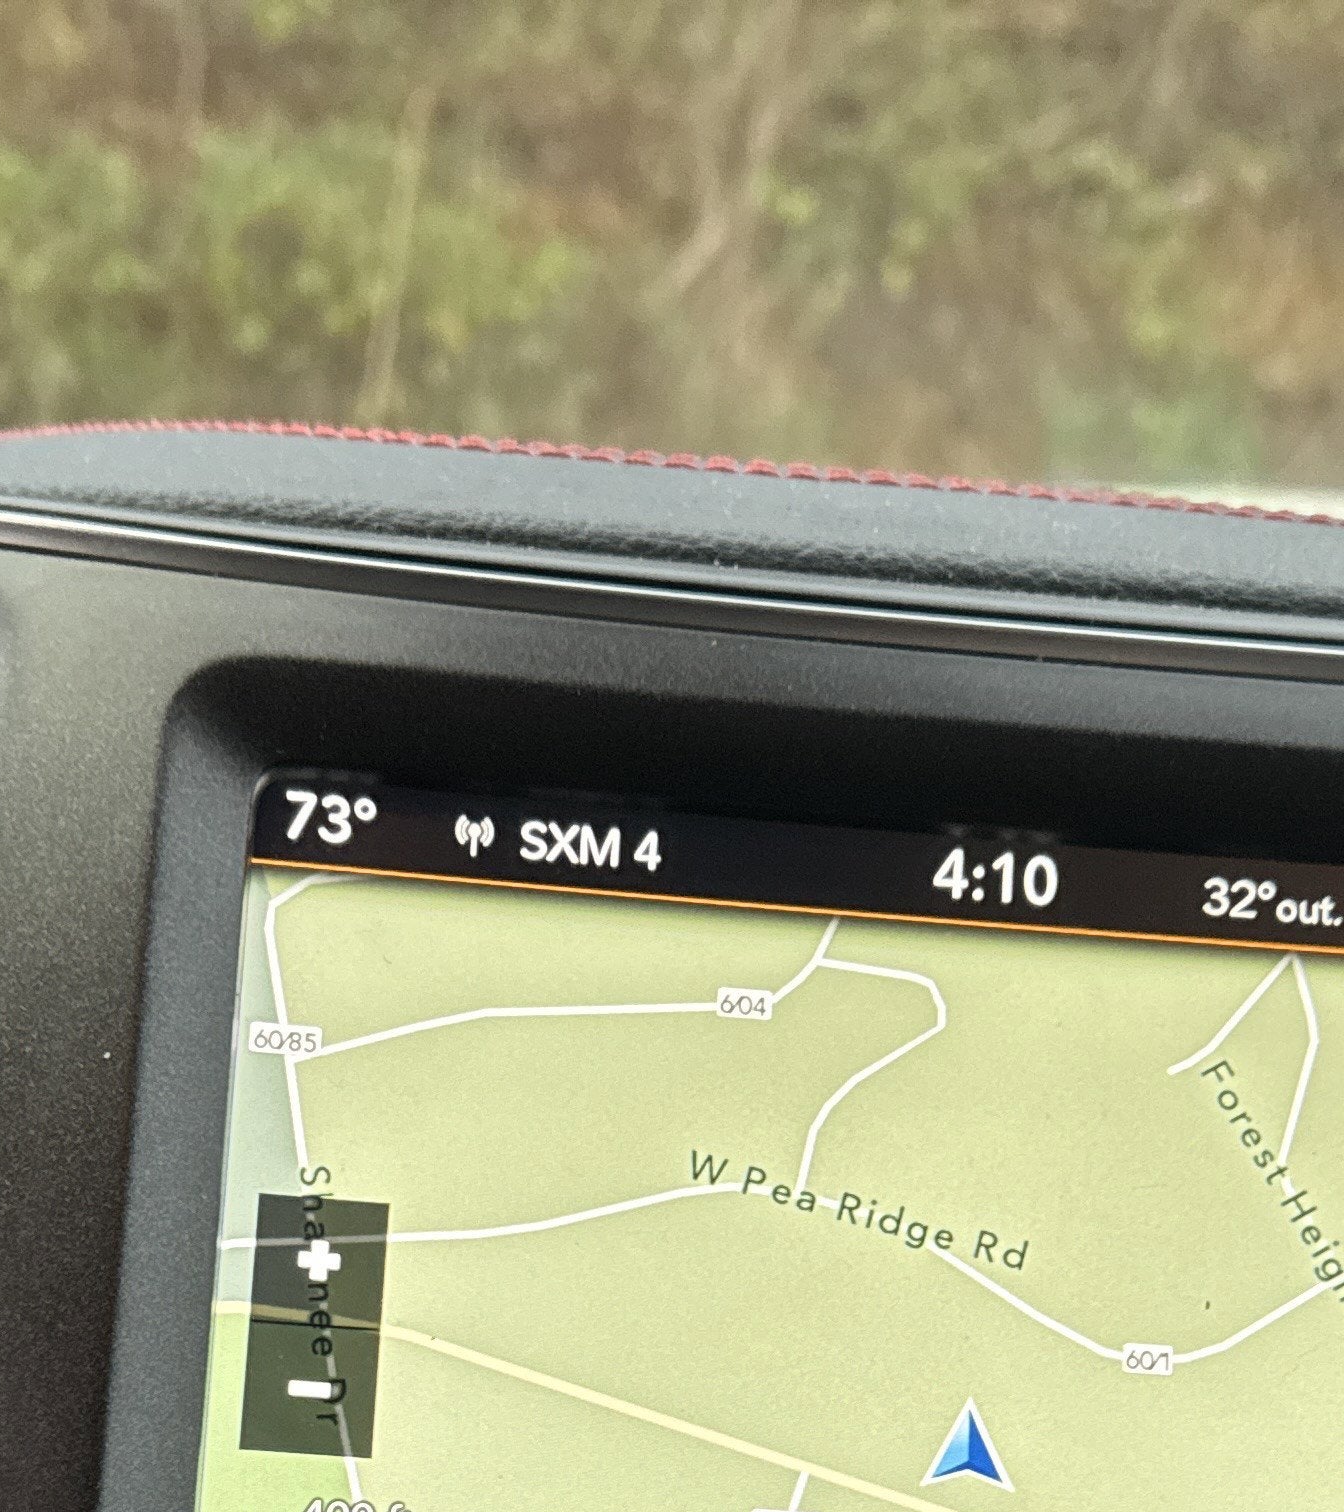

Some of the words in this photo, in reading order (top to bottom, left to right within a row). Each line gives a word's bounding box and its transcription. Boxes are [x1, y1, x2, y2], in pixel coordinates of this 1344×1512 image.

[284, 788, 379, 845] 73°
[518, 819, 622, 869] SXM
[632, 829, 663, 873] 4
[931, 846, 1059, 908] 4:10
[1200, 1059, 1288, 1186] Forest
[691, 1149, 729, 1186] W
[741, 1165, 817, 1212] Pea
[836, 1191, 954, 1251] Ridge
[973, 1229, 1029, 1271] Rd
[299, 1165, 334, 1357] Shanee
